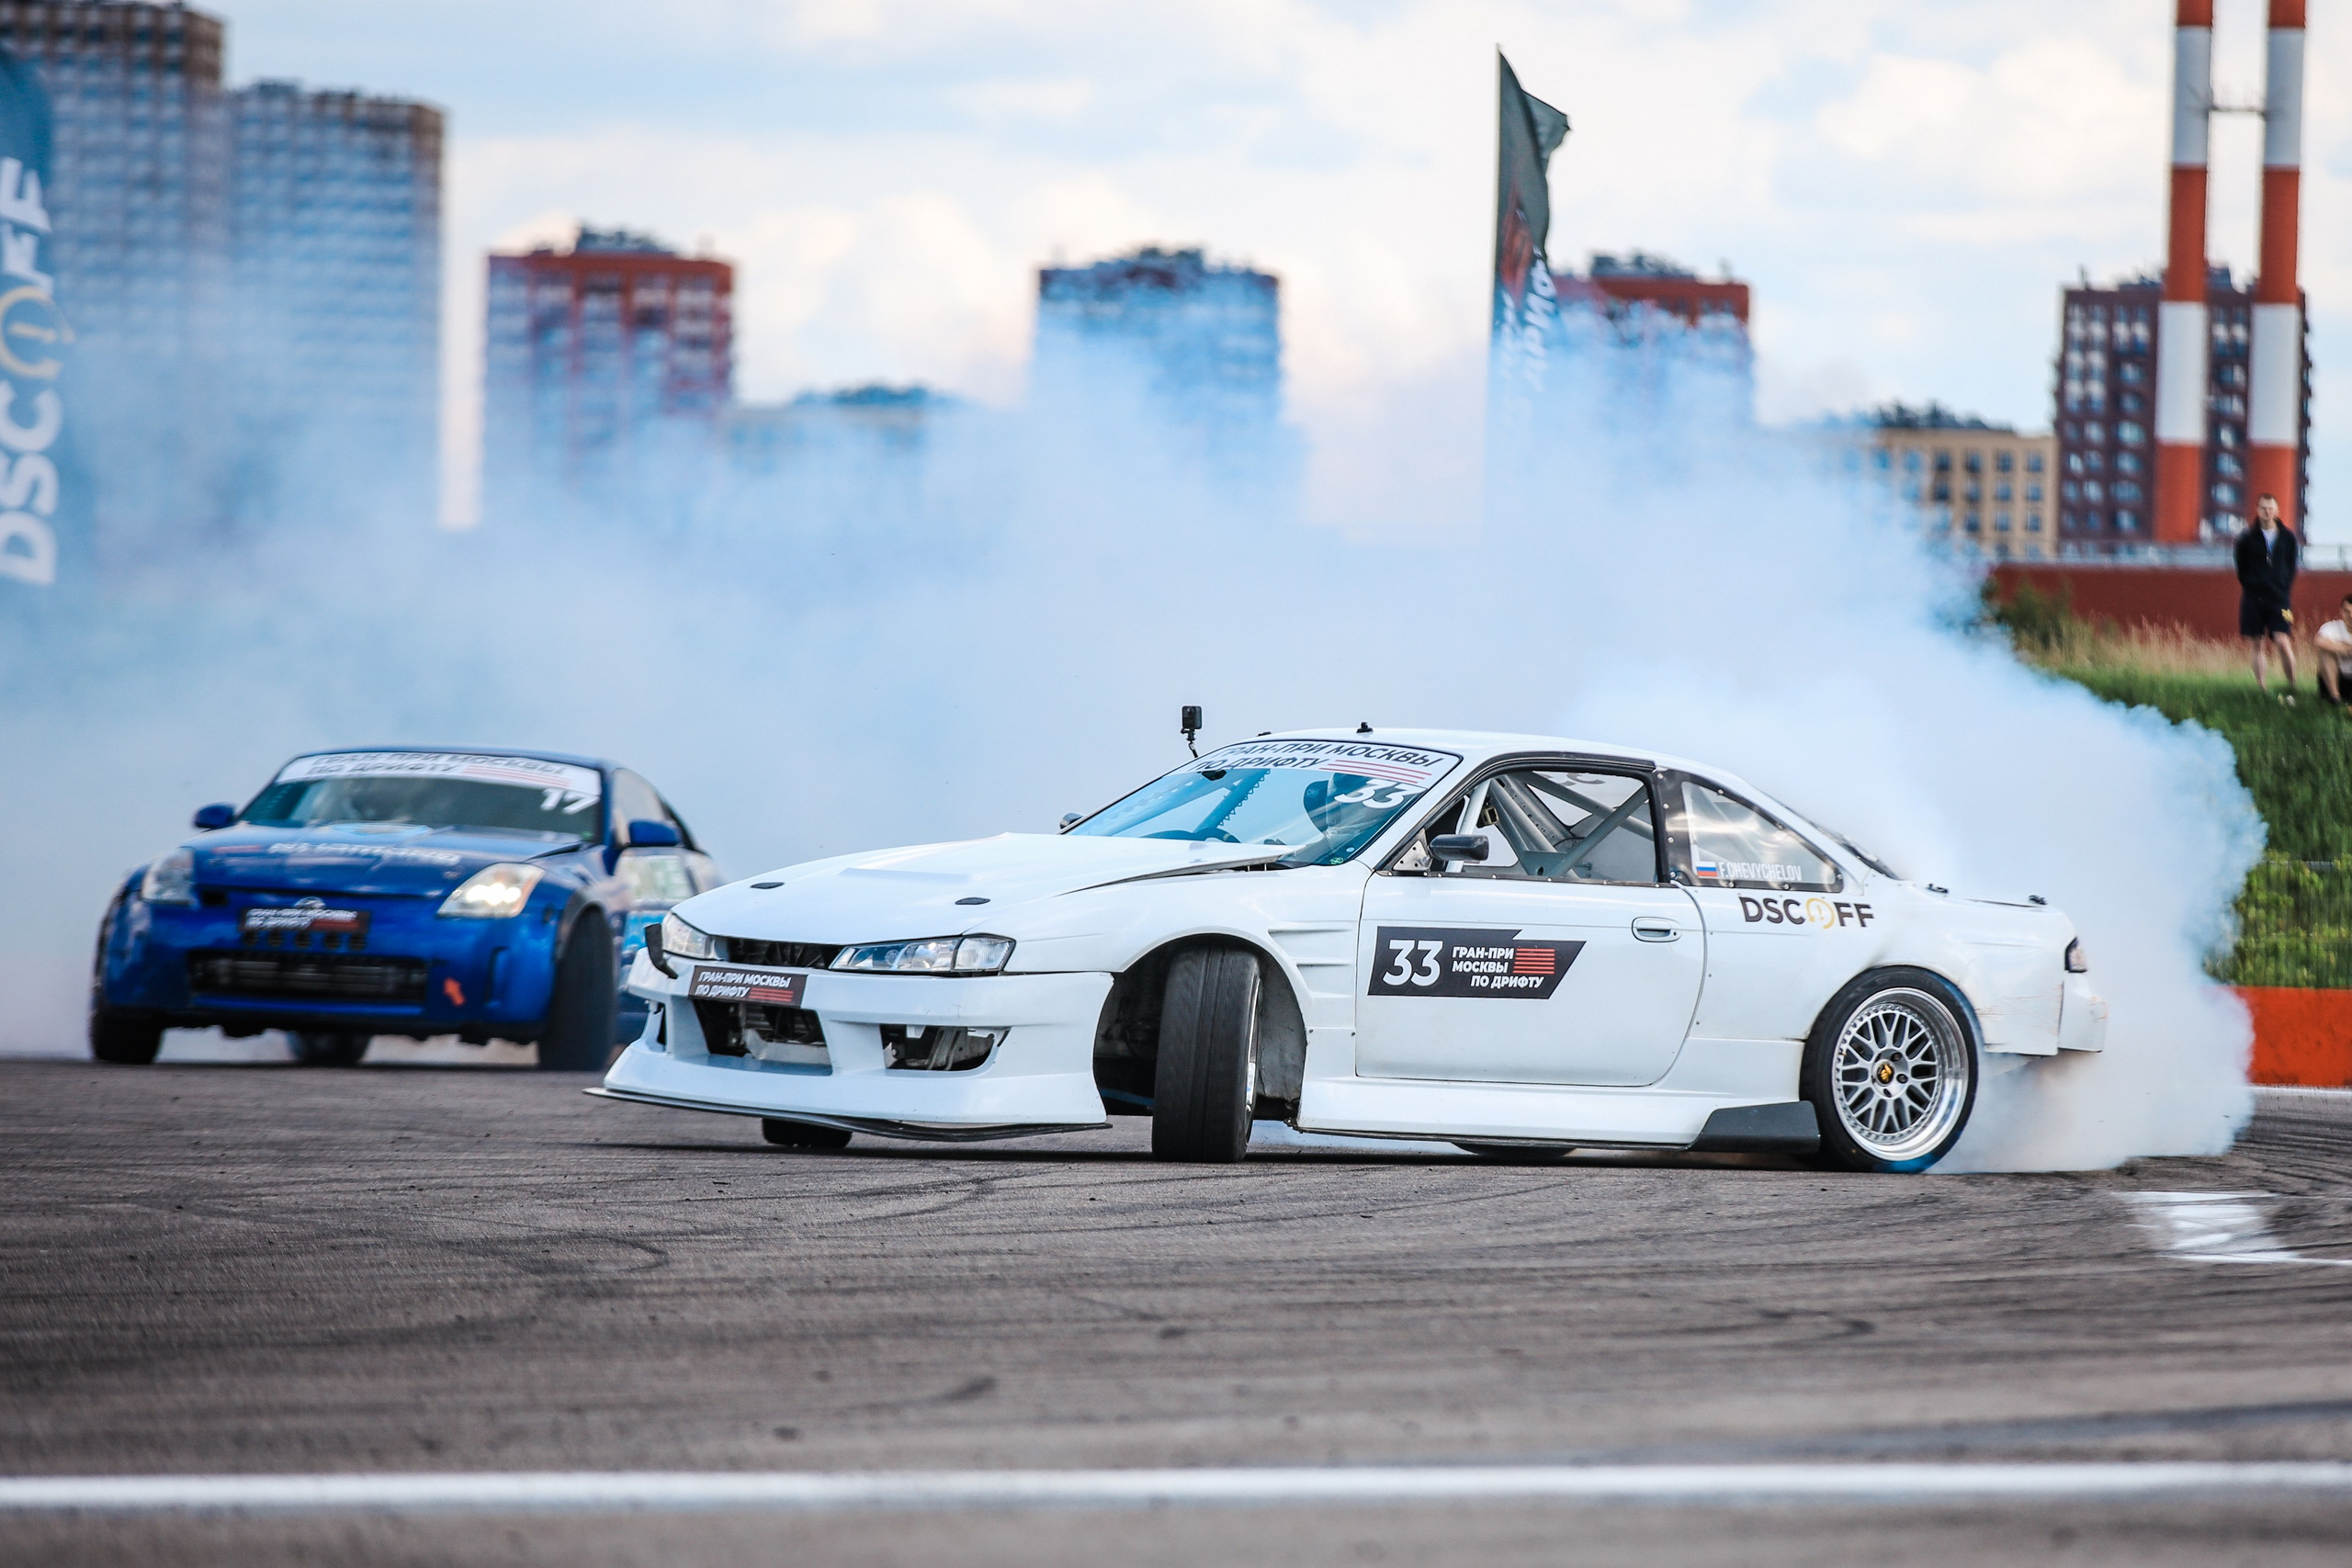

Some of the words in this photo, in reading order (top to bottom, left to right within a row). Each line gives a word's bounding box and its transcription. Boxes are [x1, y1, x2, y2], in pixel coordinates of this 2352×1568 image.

[1211, 742, 1331, 759] ГРАН-ПРИ
[1325, 744, 1445, 767] МОСКВЫ
[1187, 759, 1228, 772] ПО
[1217, 757, 1330, 771] ДРИФТУ
[539, 788, 601, 815] 17
[1334, 778, 1428, 809] 33
[1452, 946, 1514, 960] ГРАН-ПРИ
[1382, 939, 1444, 987] 33
[1452, 961, 1508, 974] МОСКВЫ
[697, 971, 745, 984] ГРАН-ПРИ
[743, 973, 792, 988] МОСКВЫ
[1471, 976, 1490, 987] ПО
[1490, 976, 1544, 989] ДРИФТУ
[694, 984, 710, 996] ПО
[707, 985, 751, 998] ДРИФТУ
